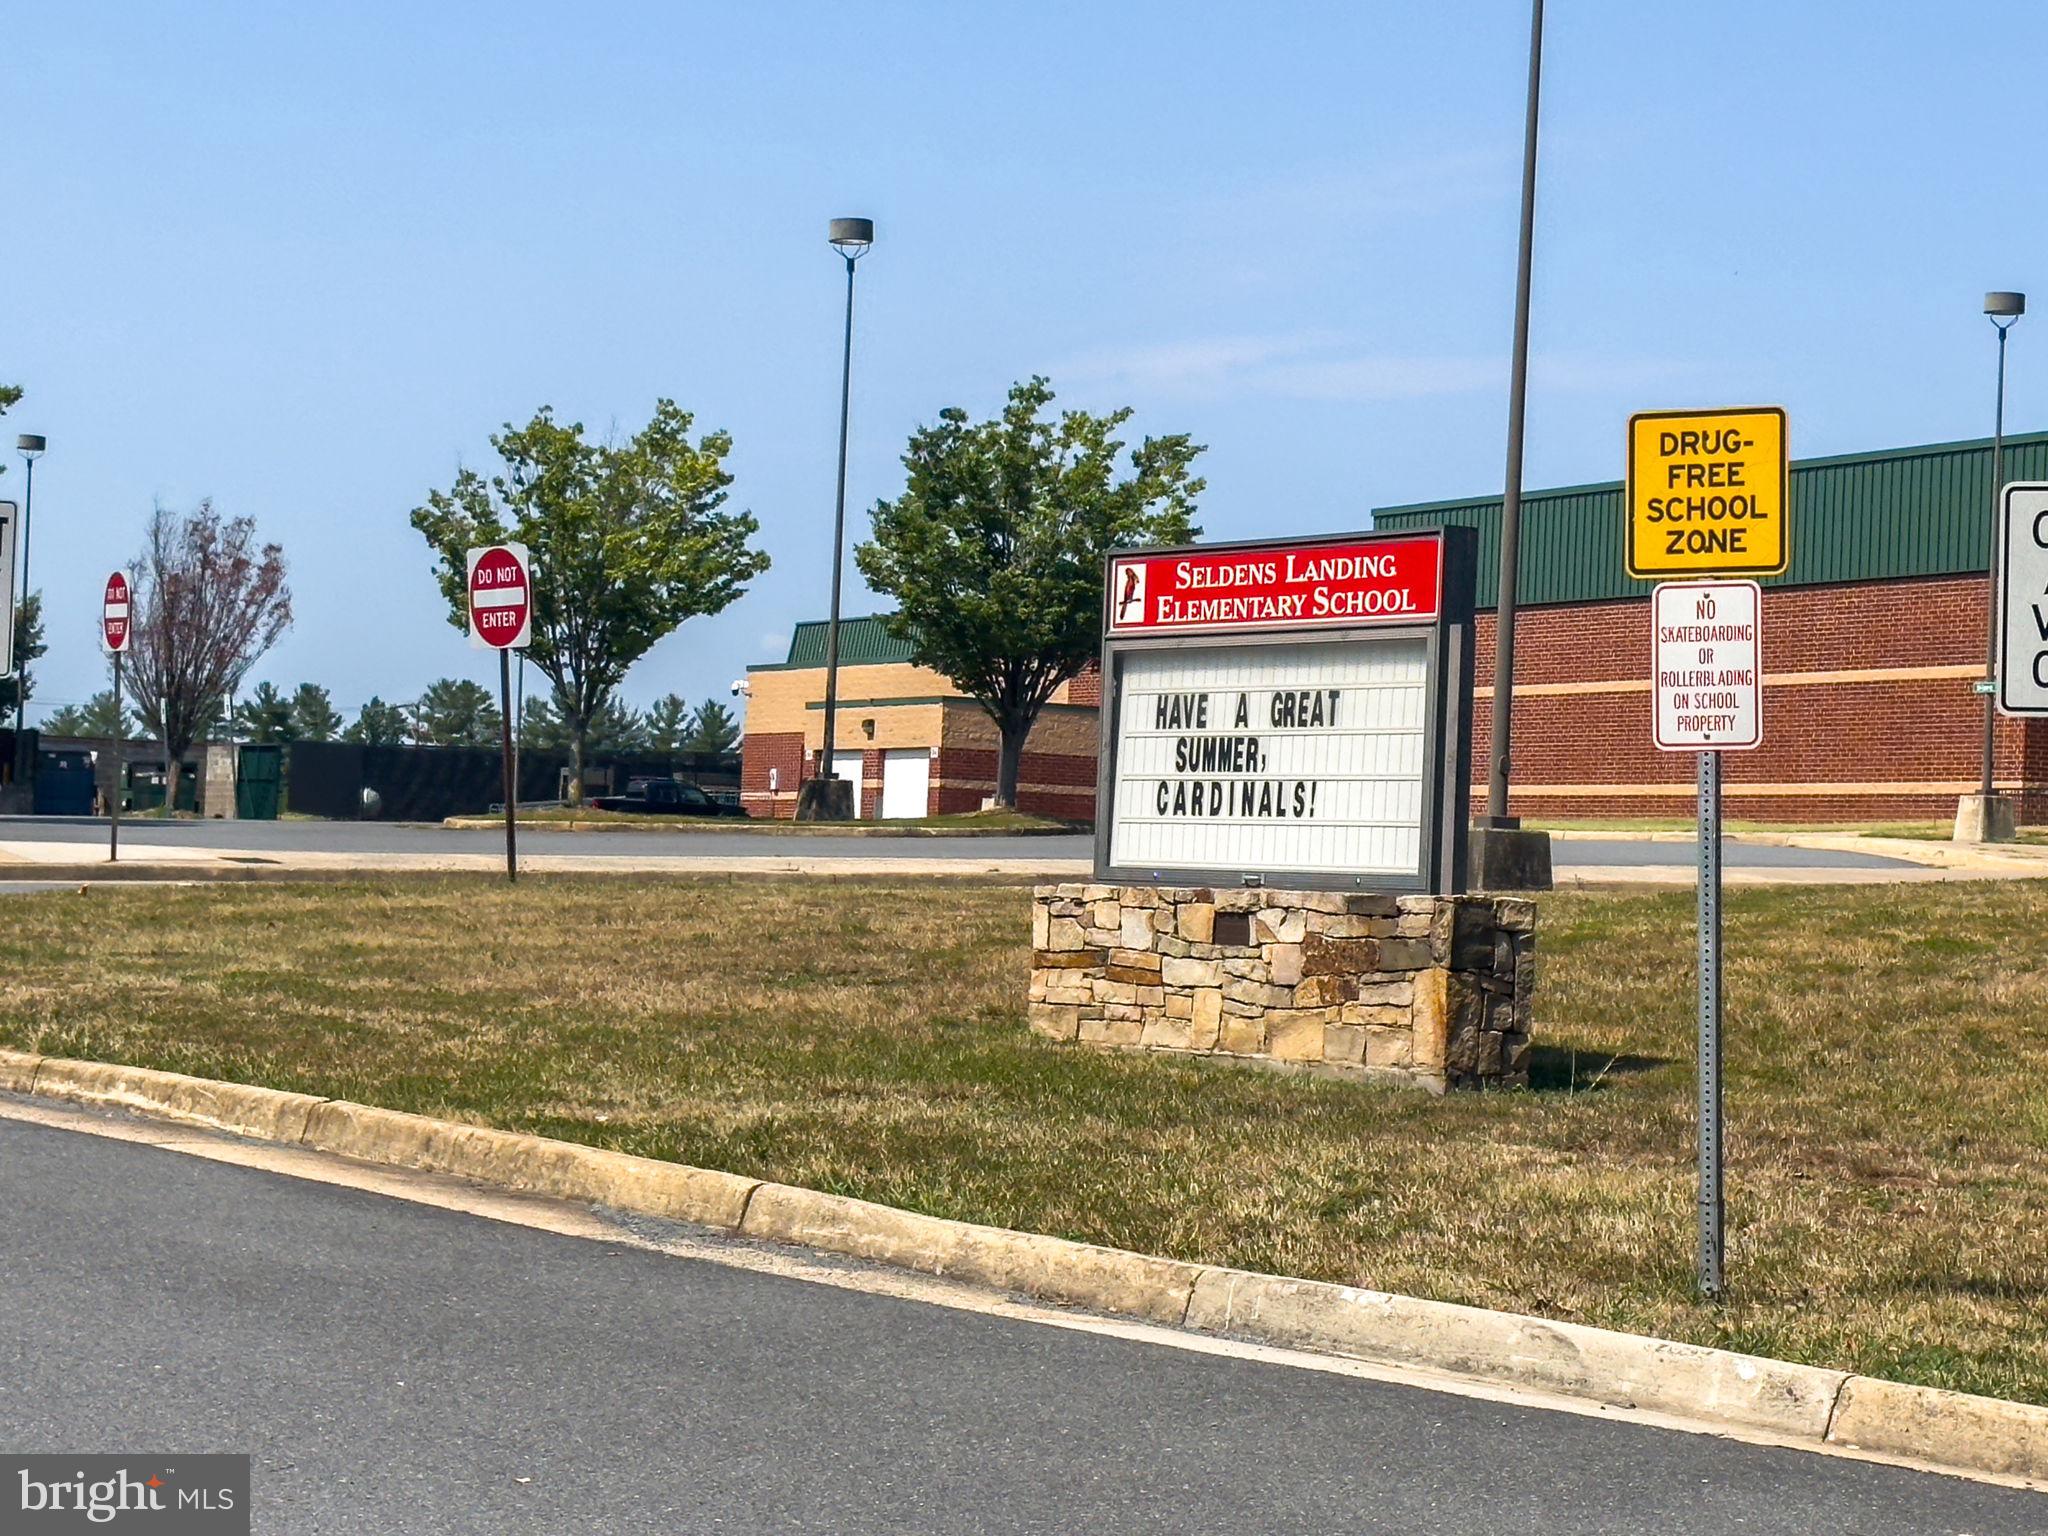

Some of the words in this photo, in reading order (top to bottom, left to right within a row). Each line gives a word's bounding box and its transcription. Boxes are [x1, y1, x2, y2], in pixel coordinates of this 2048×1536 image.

[1660, 428, 1754, 457] DRUG-
[1668, 461, 1745, 489] FREE
[1646, 494, 1768, 523] SCHOOL
[1665, 527, 1747, 555] ZONE
[478, 568, 493, 585] DO
[497, 566, 517, 583] NOT
[482, 611, 516, 629] ENTER
[1696, 599, 1716, 620] NO
[1660, 624, 1753, 643] SKATEBOARDING
[1698, 647, 1714, 665] OR
[1660, 669, 1753, 688] ROLLERBLADING
[1155, 693, 1209, 730] HAVE
[1234, 692, 1249, 729] A
[1270, 689, 1341, 728] GREAT
[1673, 692, 1689, 710] ON
[1694, 691, 1740, 709] SCHOOL
[1677, 714, 1736, 732] PROPERTY
[1175, 736, 1267, 774] SUMMER,
[1156, 780, 1317, 818] CARDINALS!
